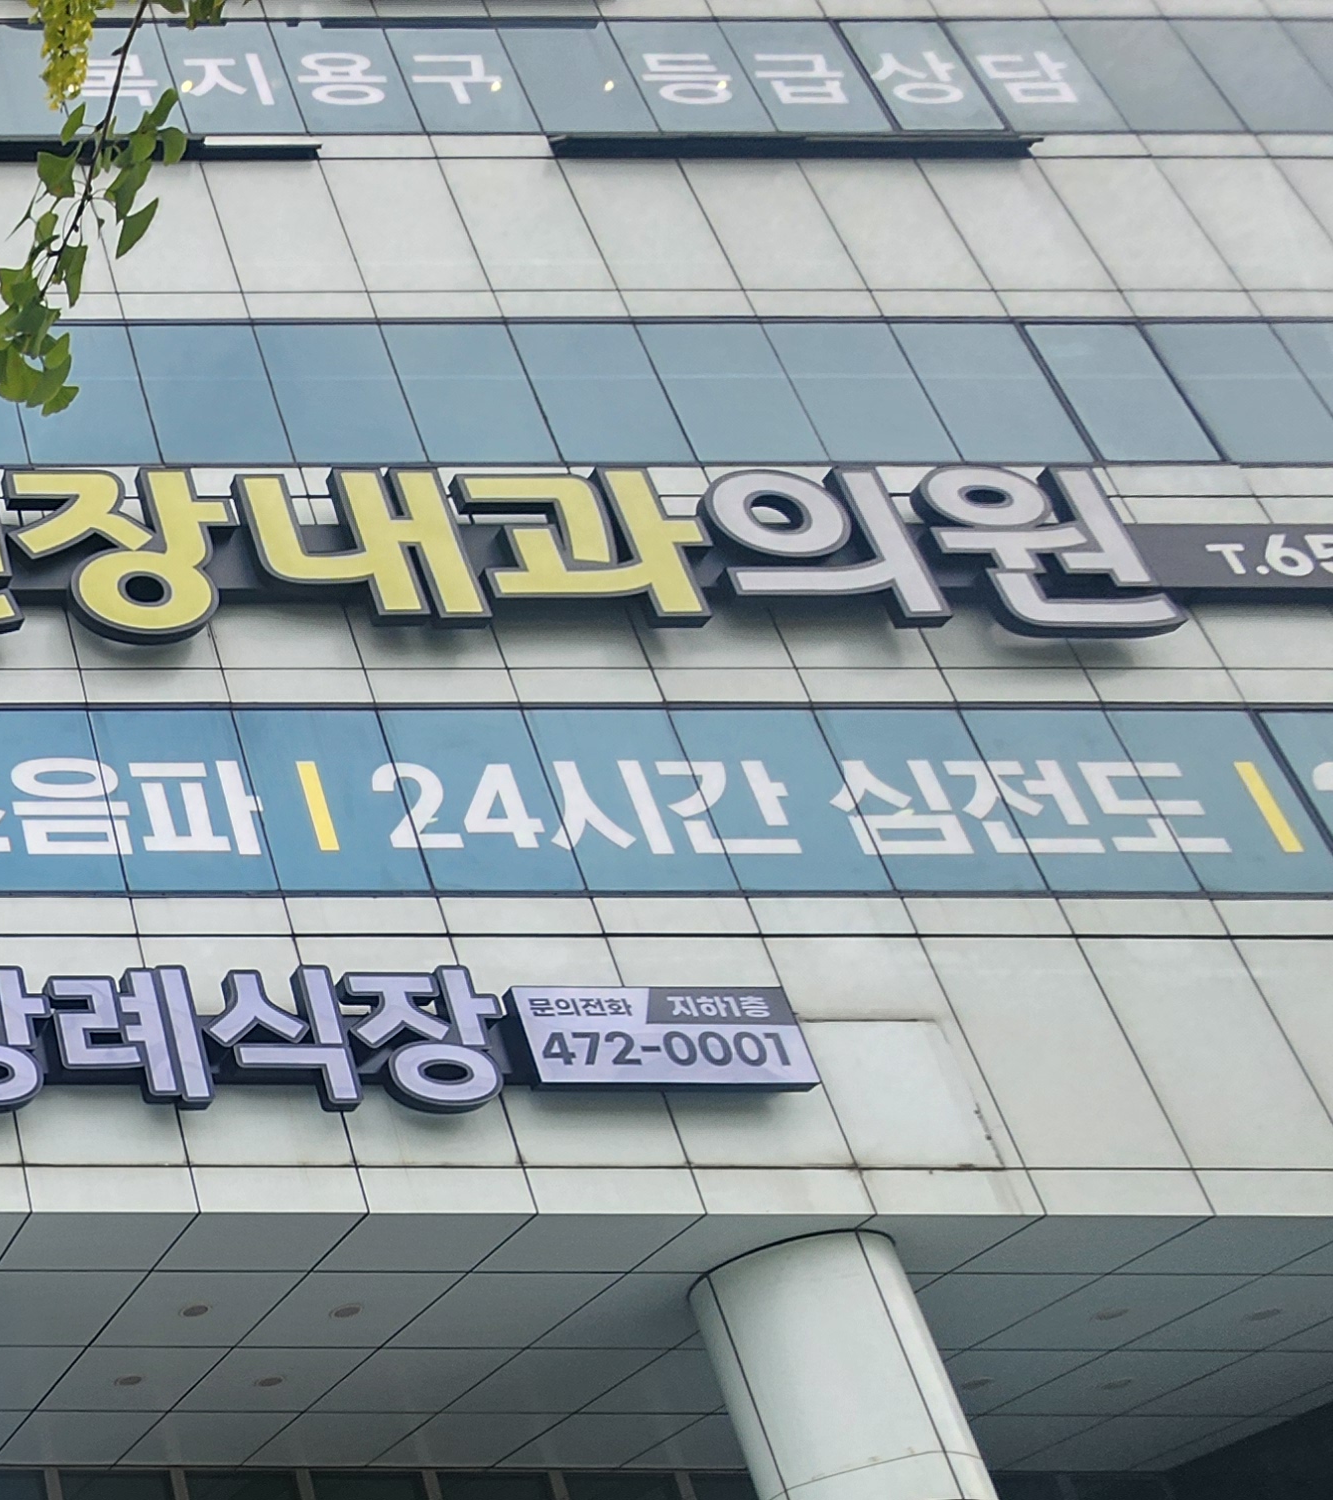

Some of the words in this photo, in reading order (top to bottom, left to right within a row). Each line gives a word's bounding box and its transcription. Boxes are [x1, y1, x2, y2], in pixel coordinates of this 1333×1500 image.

[78, 51, 502, 108] 복지용구
[641, 49, 1081, 107] 등급상담
[370, 759, 803, 855] 24시간
[829, 758, 1232, 855] 심전도
[528, 997, 634, 1017] 문의전화
[666, 995, 771, 1019] 지하1층
[541, 1031, 792, 1067] 472-0001
